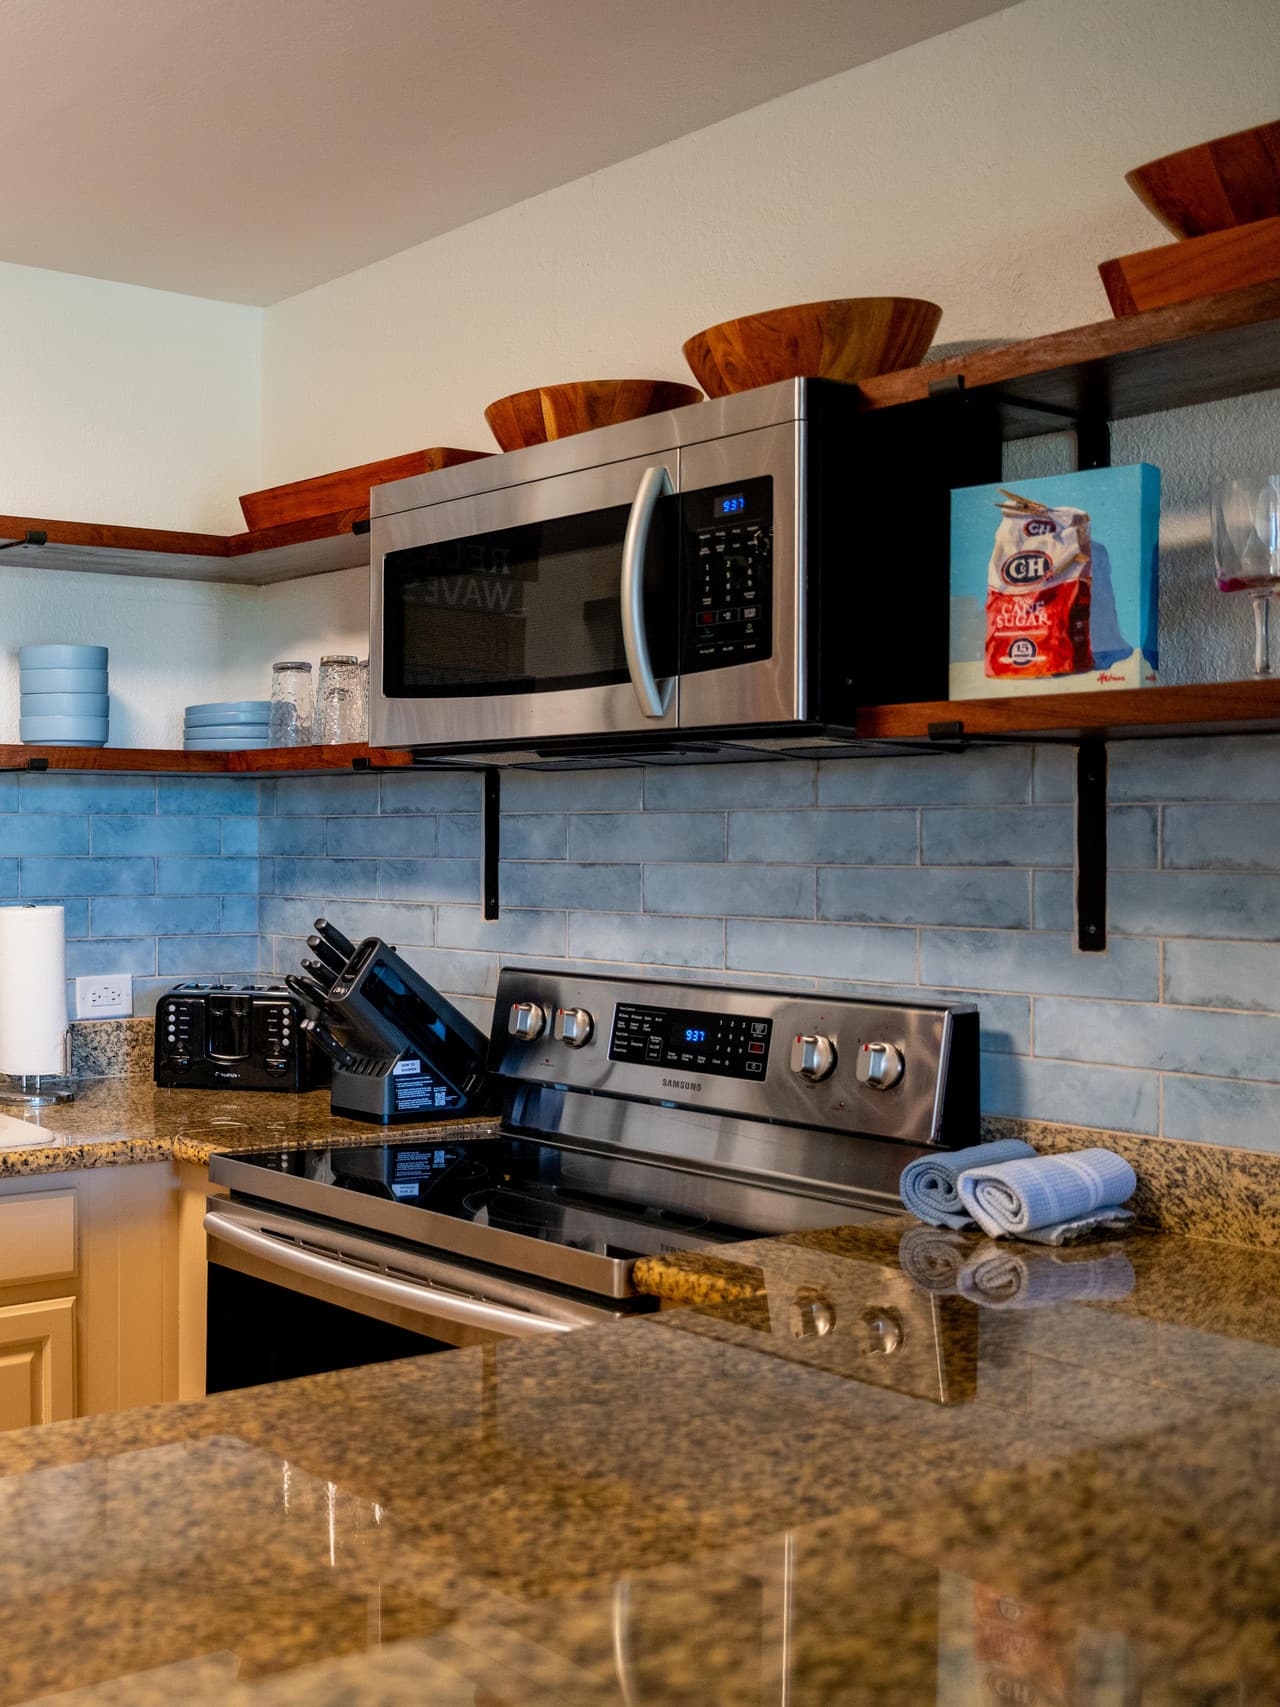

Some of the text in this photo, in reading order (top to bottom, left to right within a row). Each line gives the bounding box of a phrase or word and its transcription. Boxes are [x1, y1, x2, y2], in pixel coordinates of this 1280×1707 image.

[1001, 600, 1045, 616] CANE
[996, 613, 1052, 628] SUGAR
[662, 1078, 702, 1092] SAMSUNG
